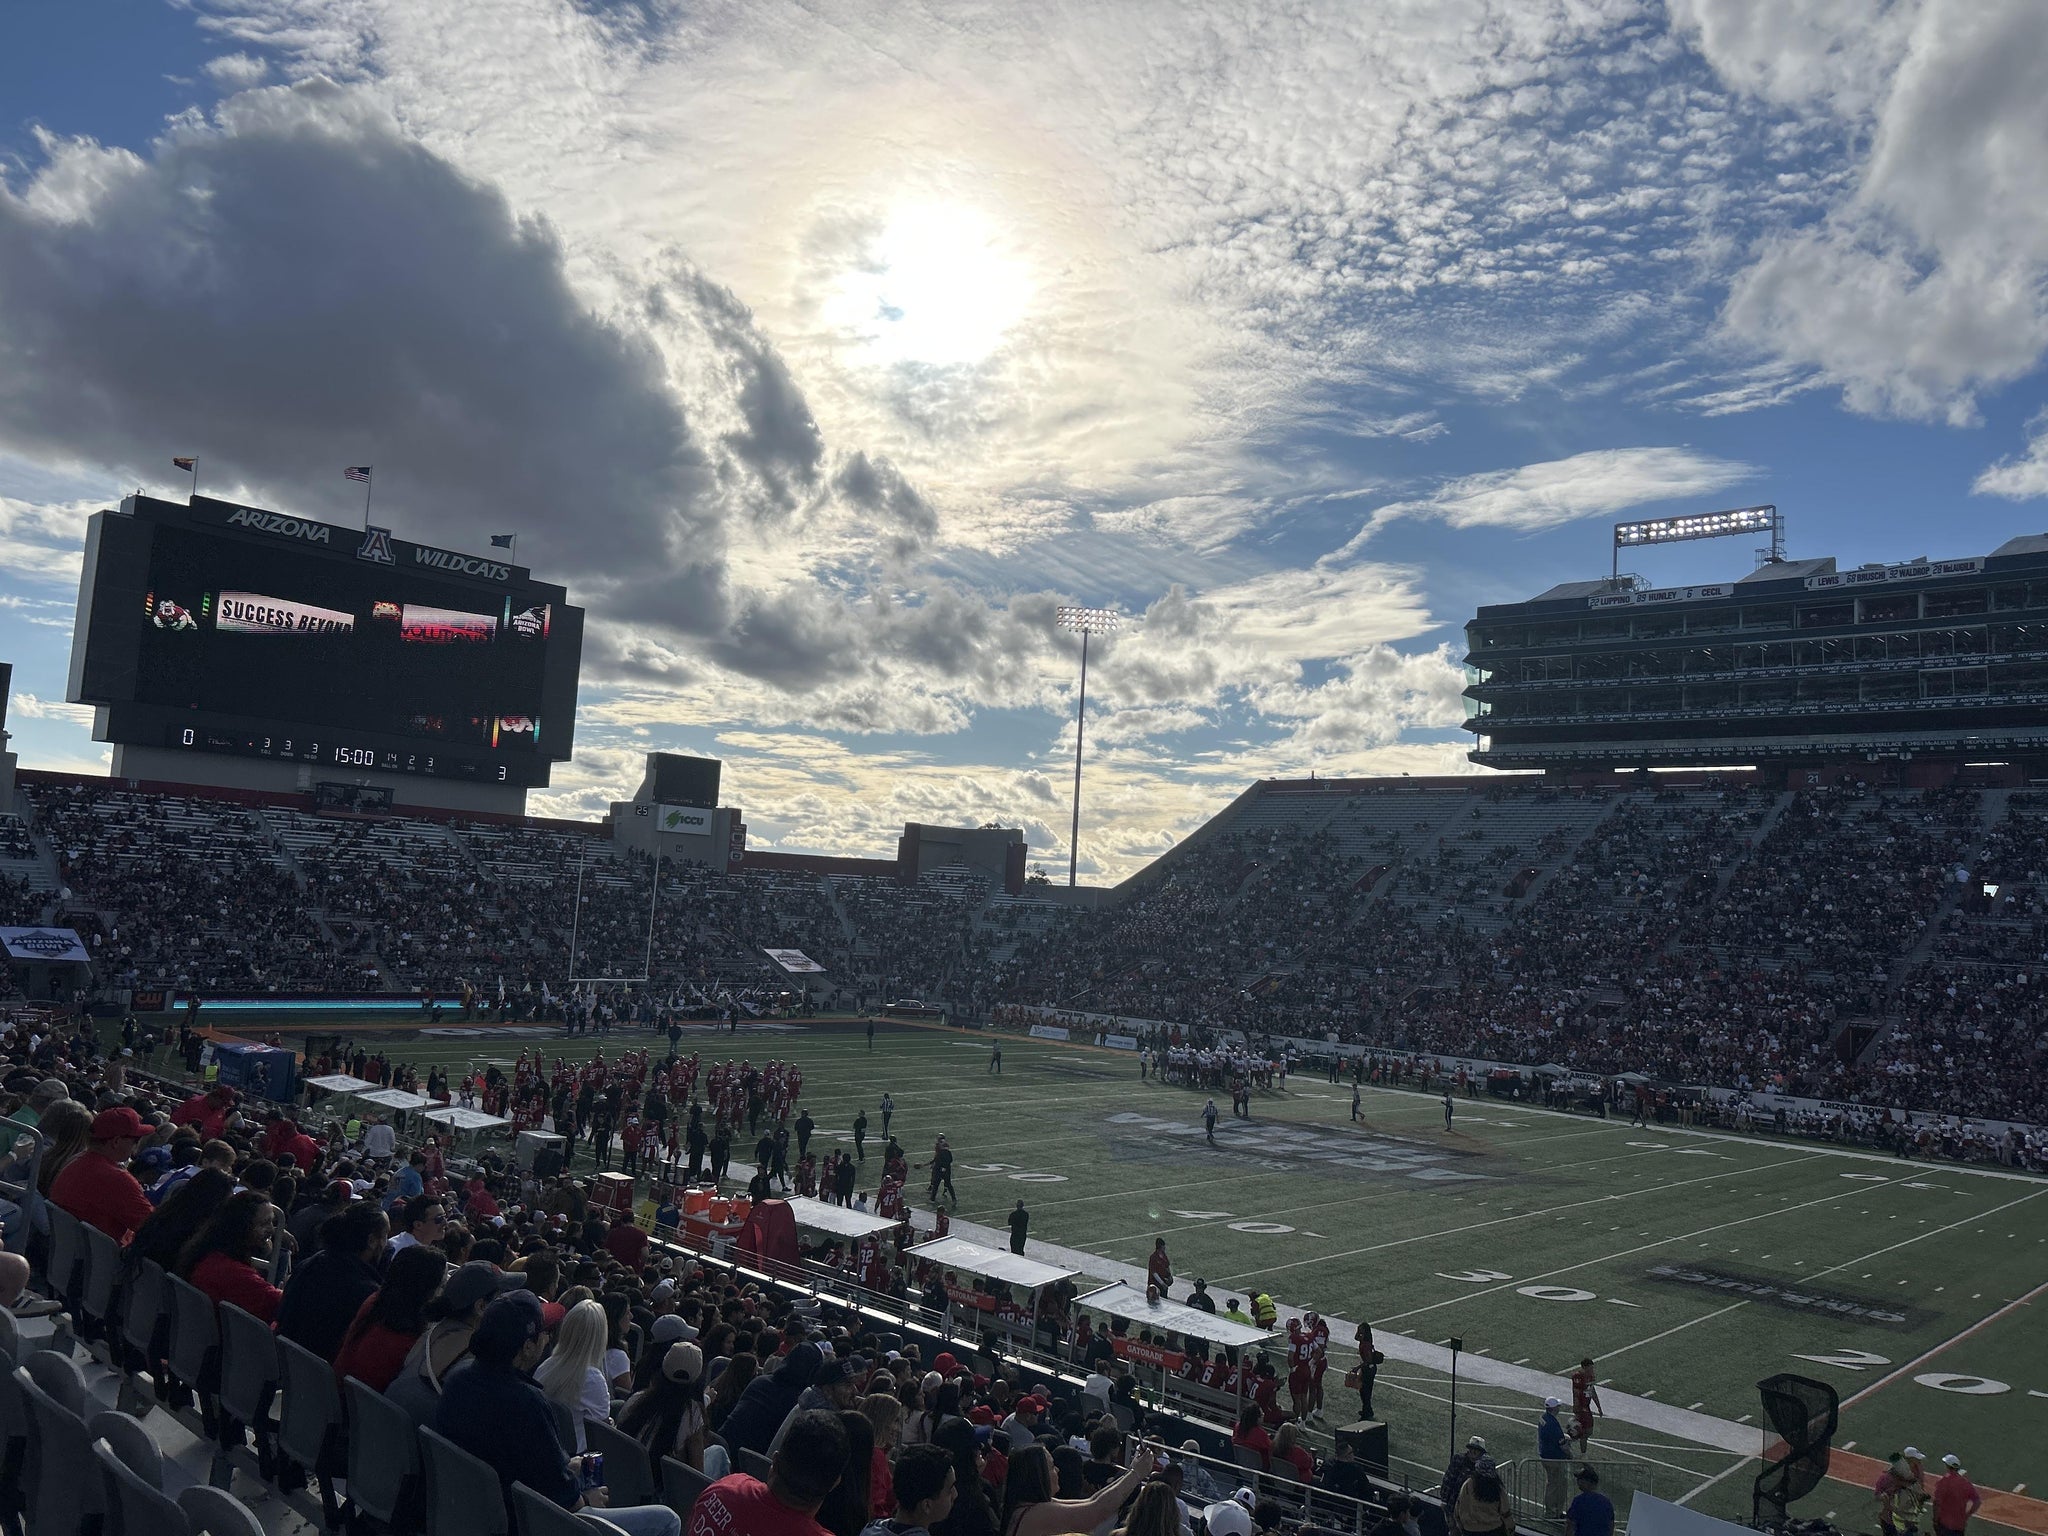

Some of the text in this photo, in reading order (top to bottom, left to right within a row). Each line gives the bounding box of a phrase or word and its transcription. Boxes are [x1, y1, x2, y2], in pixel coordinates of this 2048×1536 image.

[227, 509, 330, 543] ARIZONA
[357, 525, 395, 566] A
[415, 548, 511, 581] WILDCATS
[1857, 572, 1886, 582] BRUSCHI
[1900, 567, 1930, 578] WALDROP
[1818, 576, 1840, 586] LEWIS
[1648, 592, 1676, 600] HUNLEY
[1687, 588, 1722, 598] 6 CECIL
[1601, 596, 1630, 605] LUPPINO
[222, 599, 294, 628] SUCCESS
[512, 619, 540, 630] ARIZONA
[517, 625, 536, 634] BOWL
[182, 728, 194, 746] 0
[264, 738, 270, 748] 3
[284, 740, 292, 750] 3
[312, 744, 318, 754] 3
[335, 748, 374, 766] 15:00
[387, 753, 397, 762] 14
[408, 755, 415, 765] 2
[428, 757, 434, 767] 3
[498, 766, 506, 780] 3
[1808, 775, 1819, 784] 21
[636, 806, 648, 816] 25
[26, 942, 67, 950] BOWL
[1364, 1047, 1391, 1056] ARIZONA
[1570, 1072, 1602, 1081] ARIZONA
[1820, 1100, 1884, 1116] ARIZONA BOW
[860, 1249, 874, 1263] 32
[1434, 1268, 1598, 1301] 30
[1126, 1344, 1164, 1362] GATORADE
[1788, 1348, 2011, 1395] 20
[704, 1492, 732, 1530] BEER
